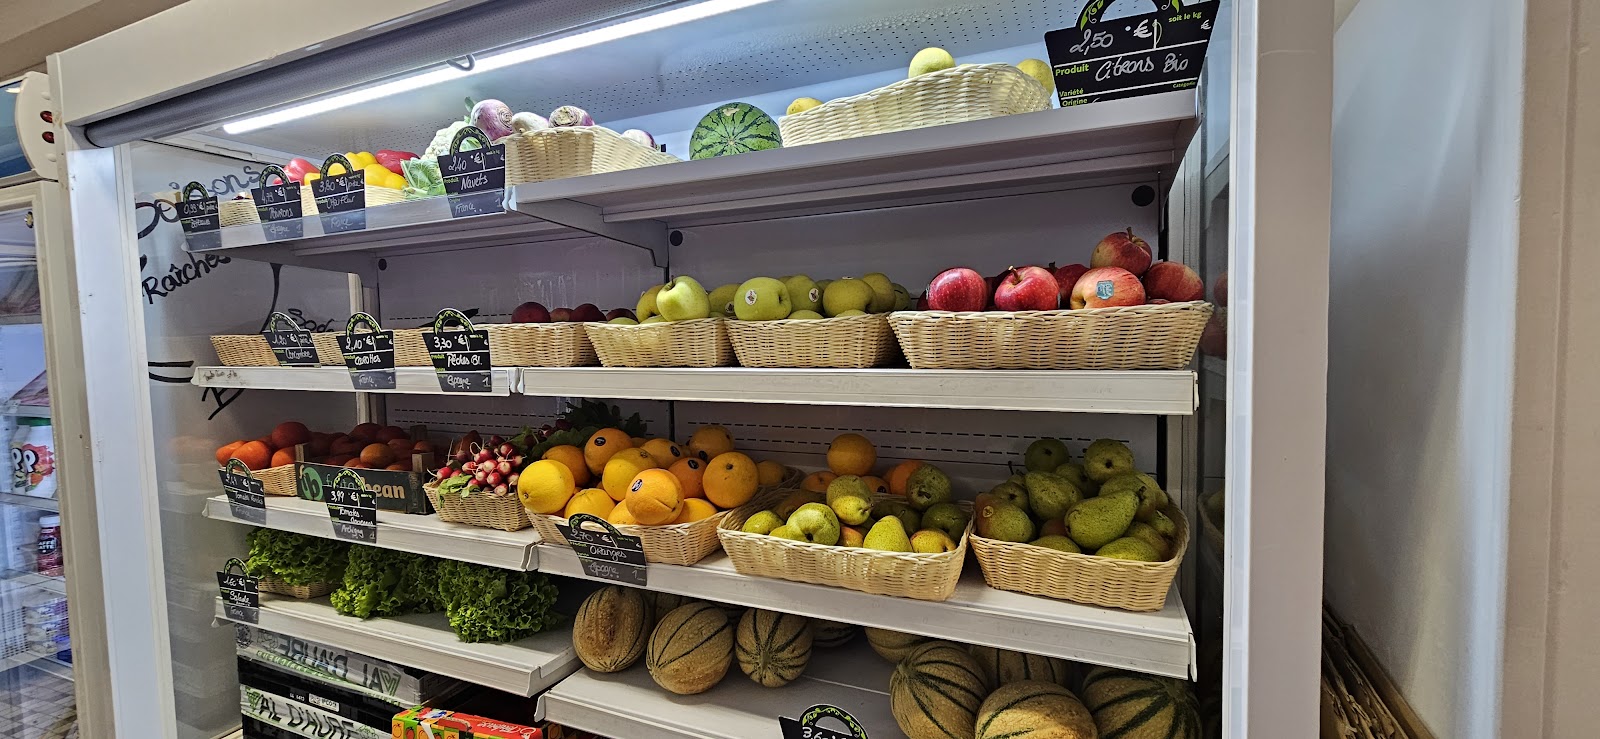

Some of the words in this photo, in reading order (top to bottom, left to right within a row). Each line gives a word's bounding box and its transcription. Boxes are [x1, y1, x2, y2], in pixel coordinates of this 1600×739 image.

[1168, 15, 1182, 23] soit
[1192, 11, 1202, 20] kg
[1069, 29, 1114, 55] 2,50
[1055, 63, 1090, 77] Produit
[1162, 52, 1189, 73] Bio
[1059, 88, 1084, 97] Variété
[1062, 98, 1088, 107] Origine
[461, 173, 488, 190] Navets
[433, 336, 453, 351] 3,30
[589, 545, 627, 562] Oranges
